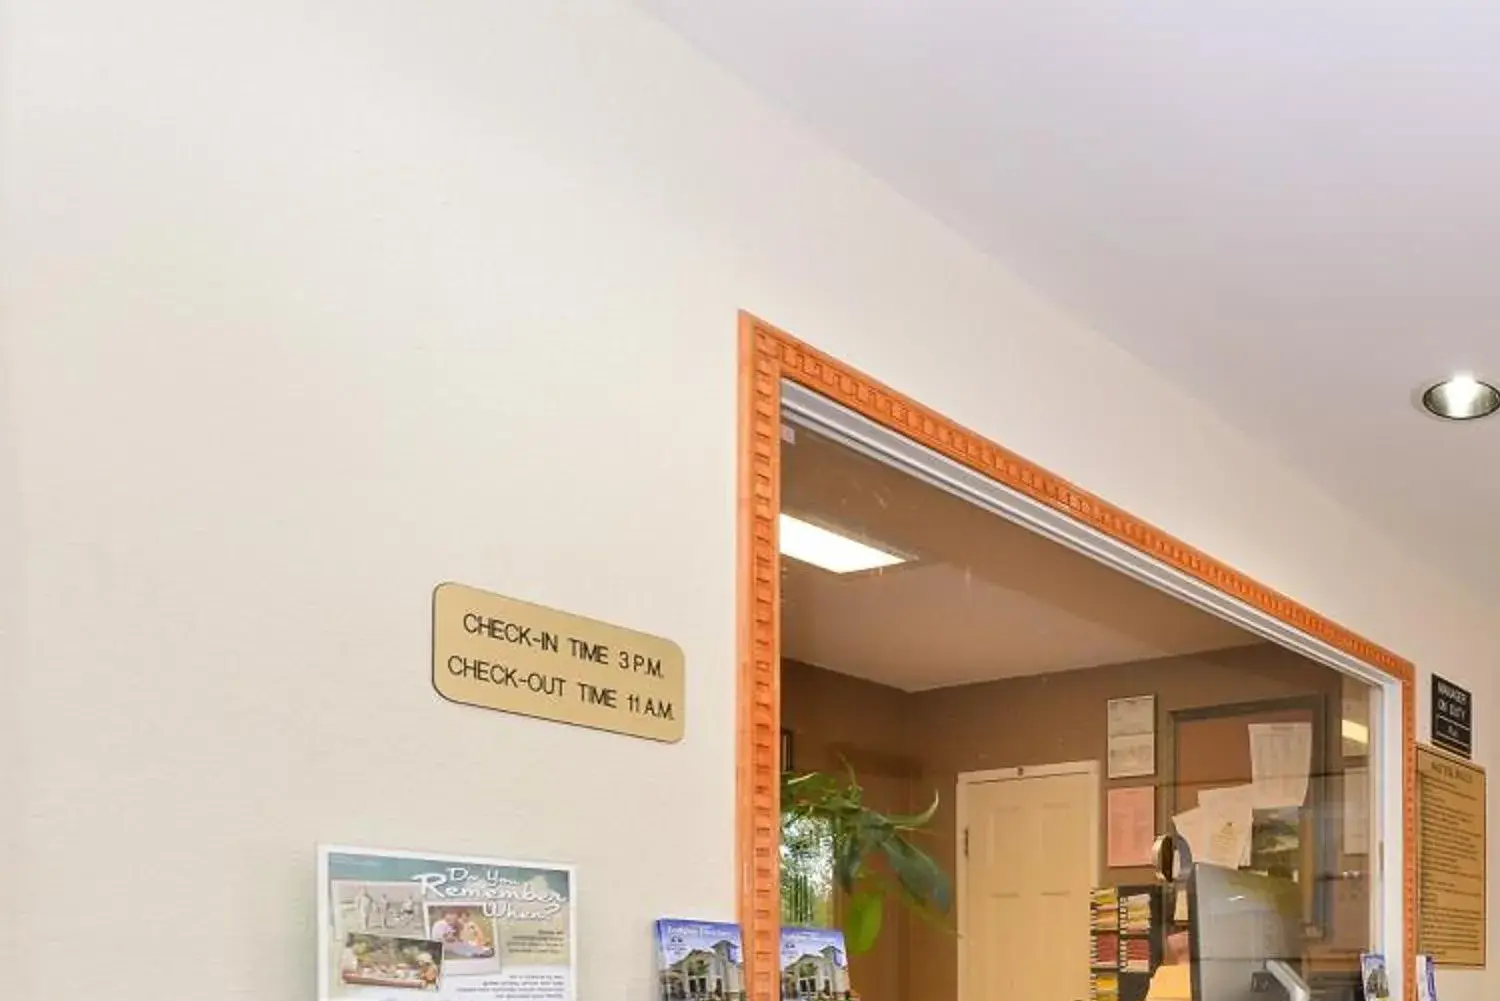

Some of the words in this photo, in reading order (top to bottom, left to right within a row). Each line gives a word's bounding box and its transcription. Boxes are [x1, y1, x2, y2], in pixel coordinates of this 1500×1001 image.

[463, 613, 559, 652] CHECK-IN
[568, 637, 609, 665] TIME
[618, 650, 630, 670] 3
[447, 655, 567, 697] CHECK-OUT
[577, 682, 617, 708] TIME
[627, 693, 640, 713] 11
[411, 873, 567, 904] Remember
